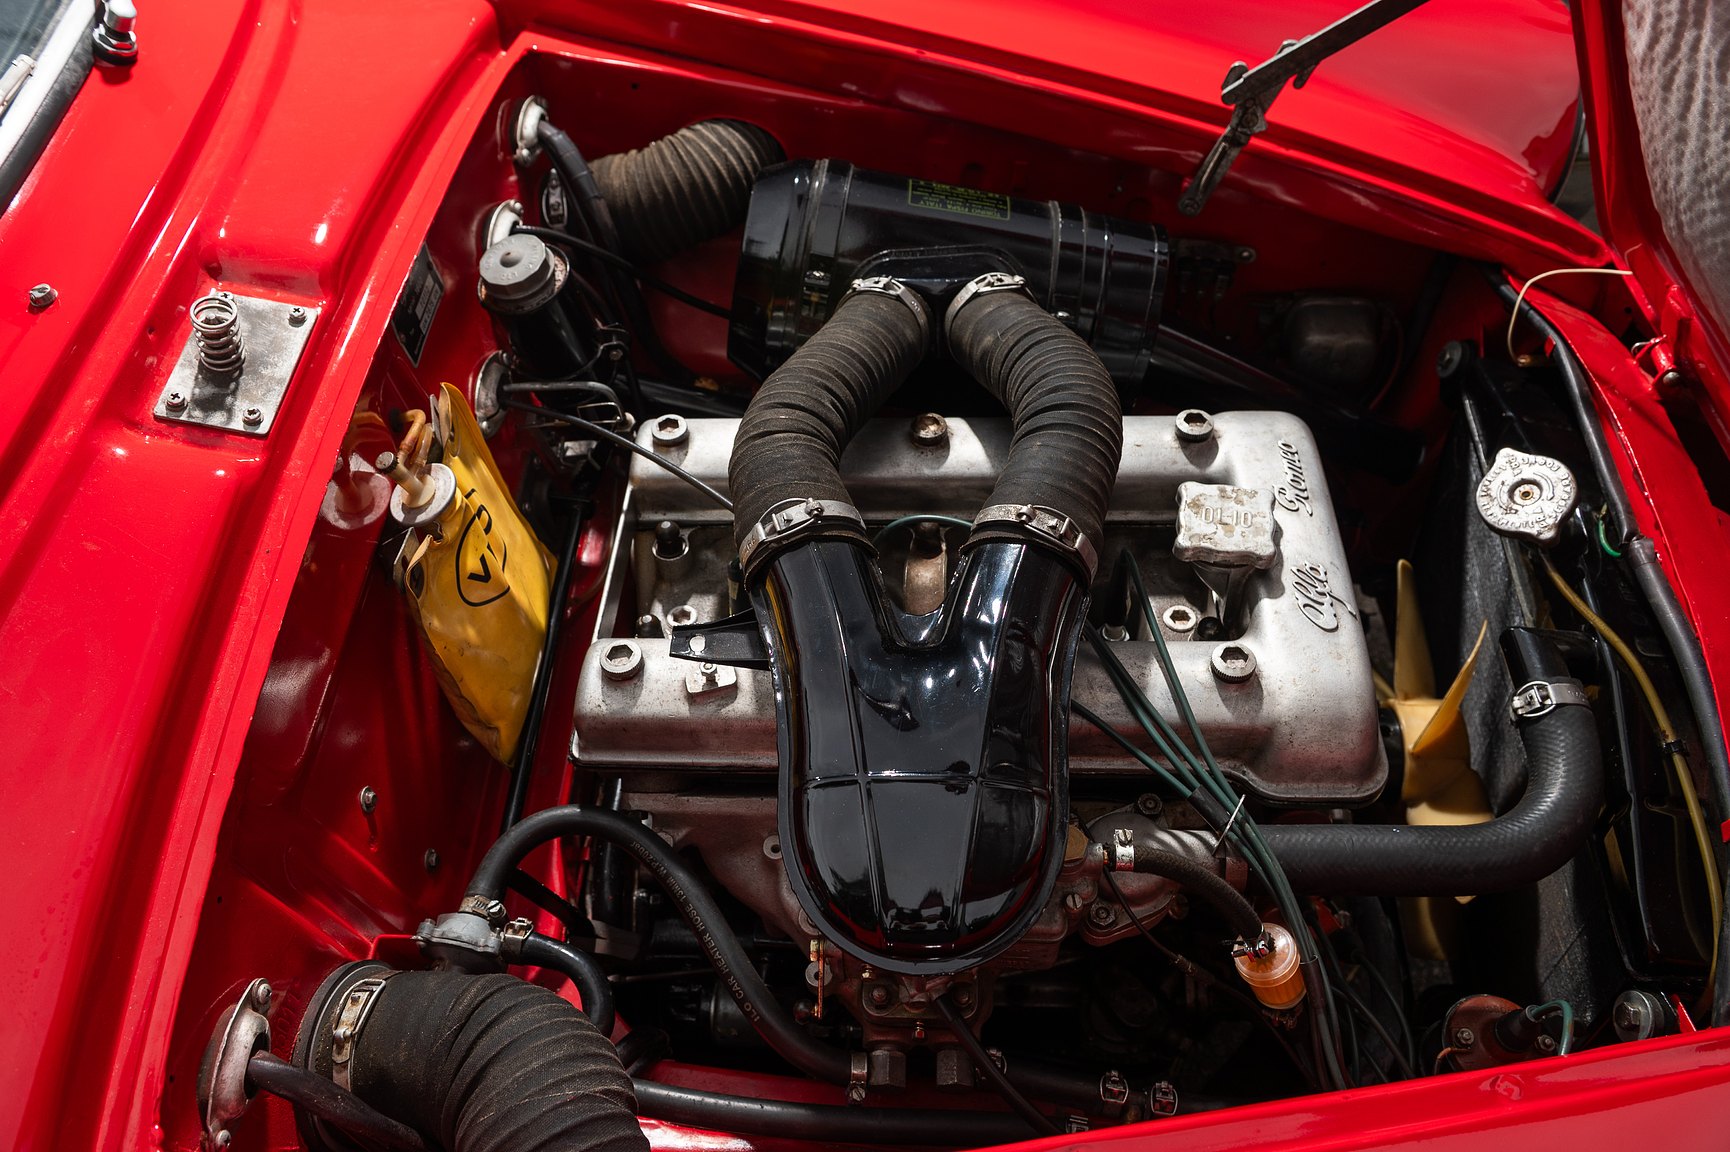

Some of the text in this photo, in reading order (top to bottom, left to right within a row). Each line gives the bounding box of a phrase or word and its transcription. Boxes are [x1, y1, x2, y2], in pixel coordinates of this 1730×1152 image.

[1201, 506, 1254, 528] OLIO
[1271, 440, 1358, 632] Alfa Romeo
[684, 903, 706, 931] HOSE
[702, 932, 730, 974] HEATER
[727, 975, 744, 999] CAR
